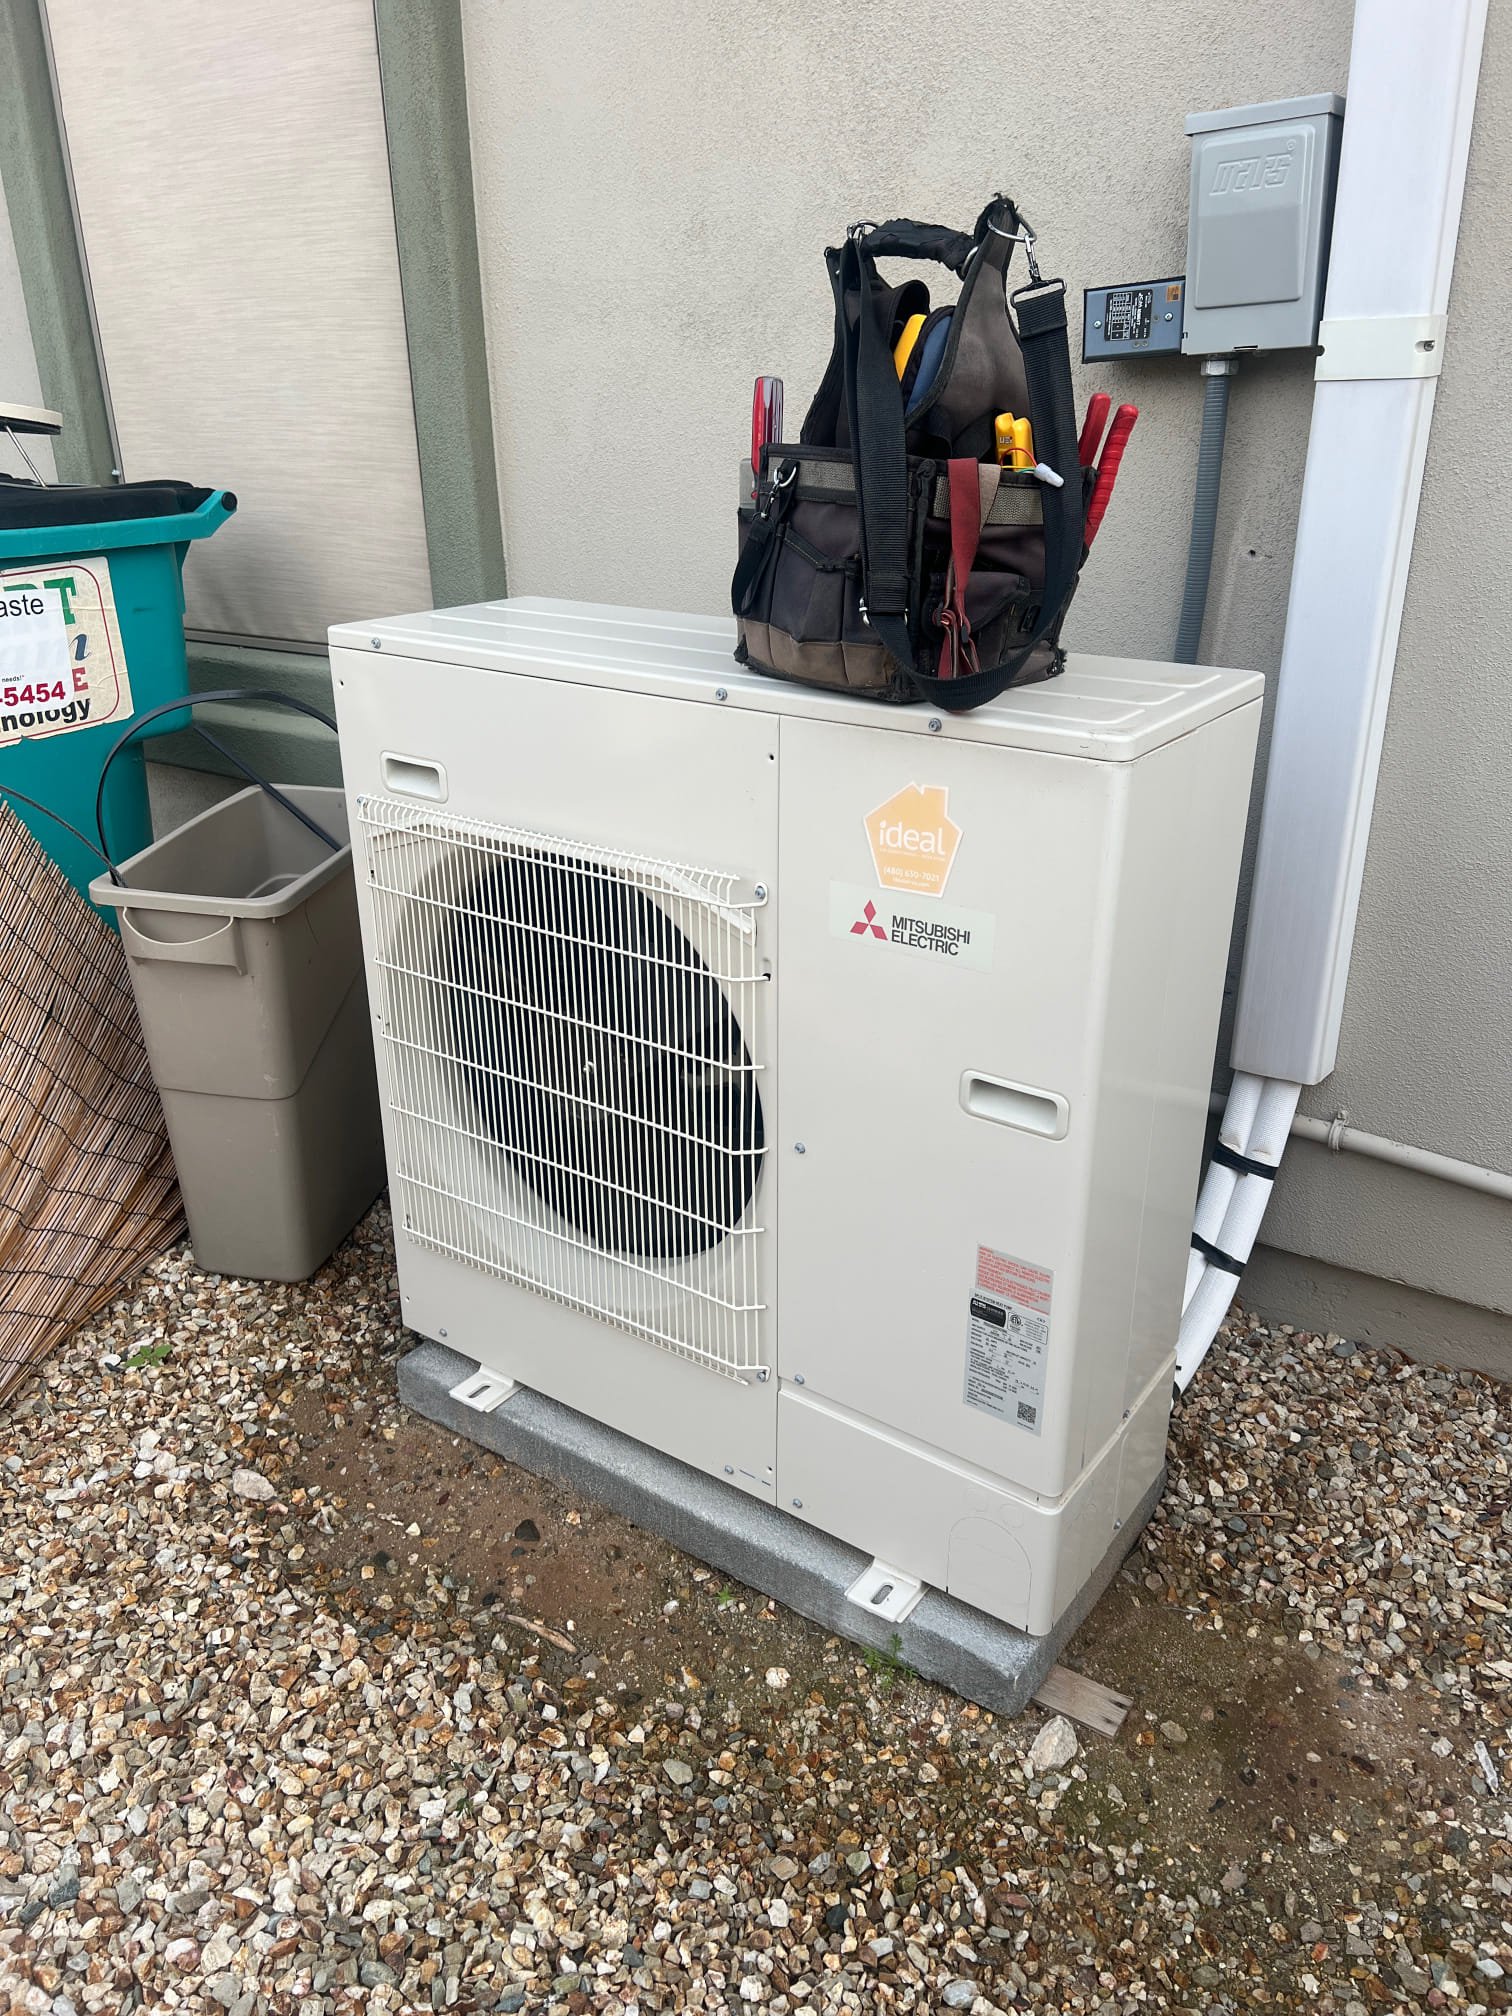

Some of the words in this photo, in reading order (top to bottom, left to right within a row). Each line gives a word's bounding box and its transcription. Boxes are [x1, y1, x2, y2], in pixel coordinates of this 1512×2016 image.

[879, 819, 946, 856] ideal
[891, 929, 959, 956] ELECTRIC
[892, 915, 971, 945] MITSUBISHI
